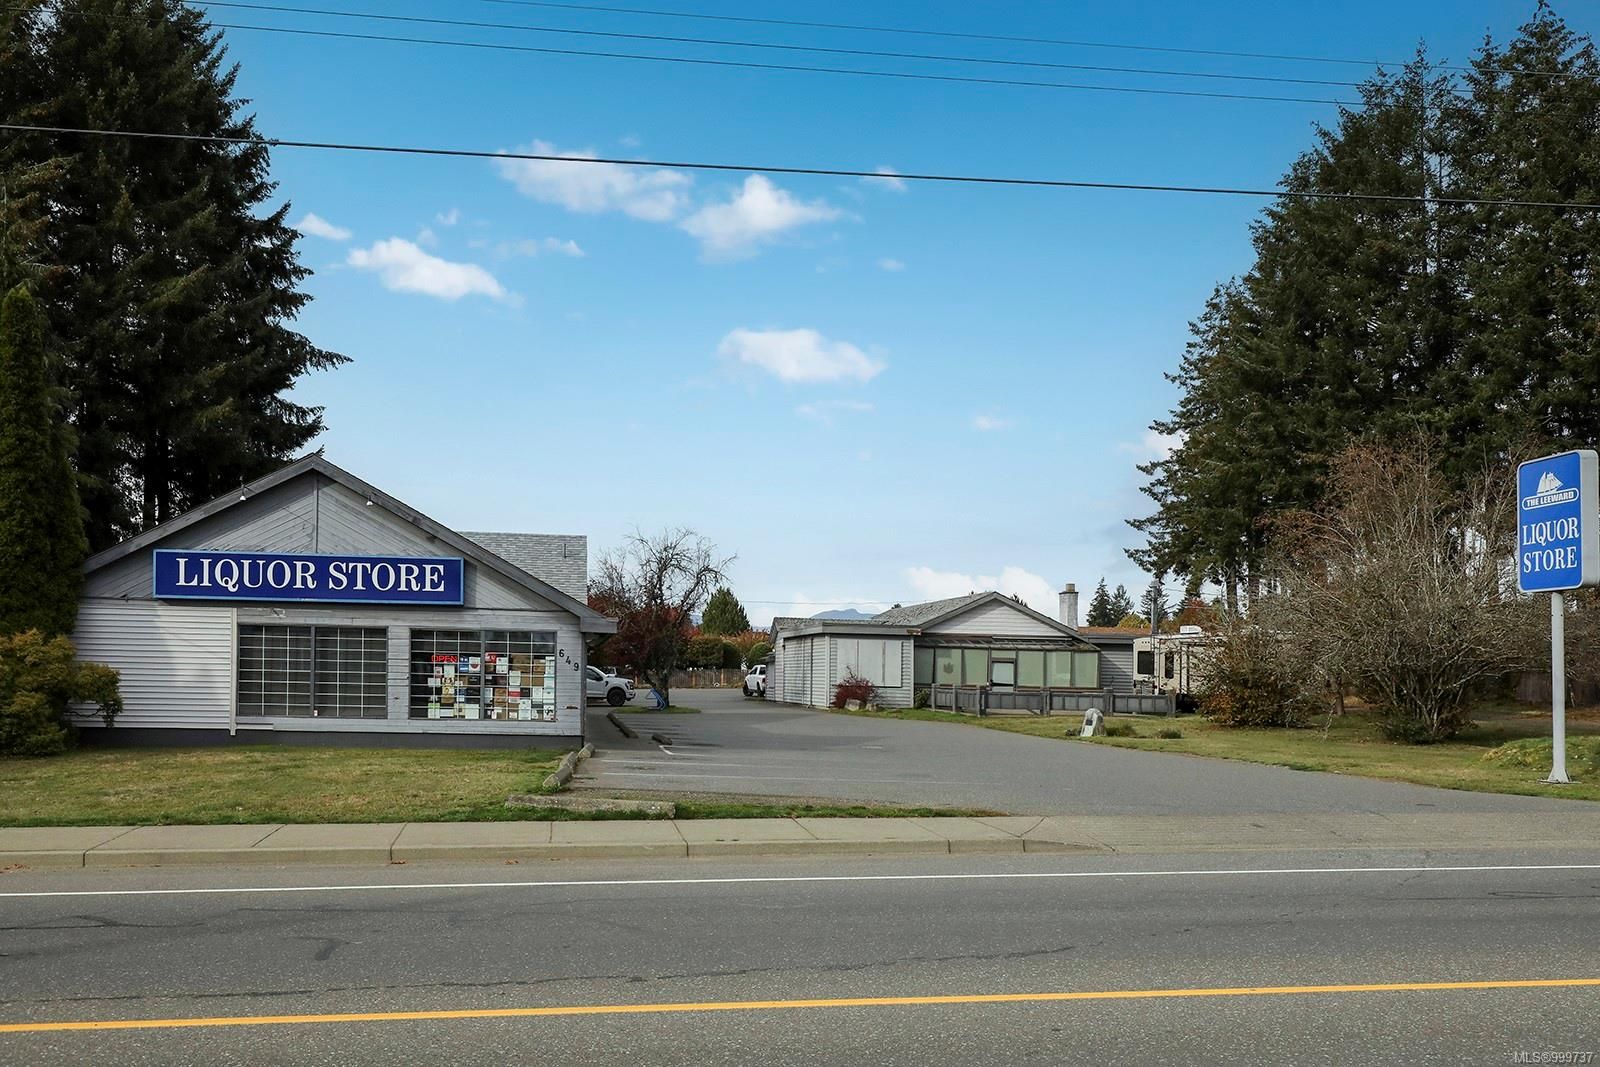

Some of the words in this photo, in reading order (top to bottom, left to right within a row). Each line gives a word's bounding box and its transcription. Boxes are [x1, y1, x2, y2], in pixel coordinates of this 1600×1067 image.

[1526, 497, 1540, 507] THE
[1540, 491, 1574, 505] LEEWARD
[1522, 517, 1580, 546] LIQUOR
[1523, 546, 1578, 573] STORE
[175, 558, 317, 592] LIQUOR
[328, 561, 445, 592] STORE
[431, 655, 458, 663] OPEN
